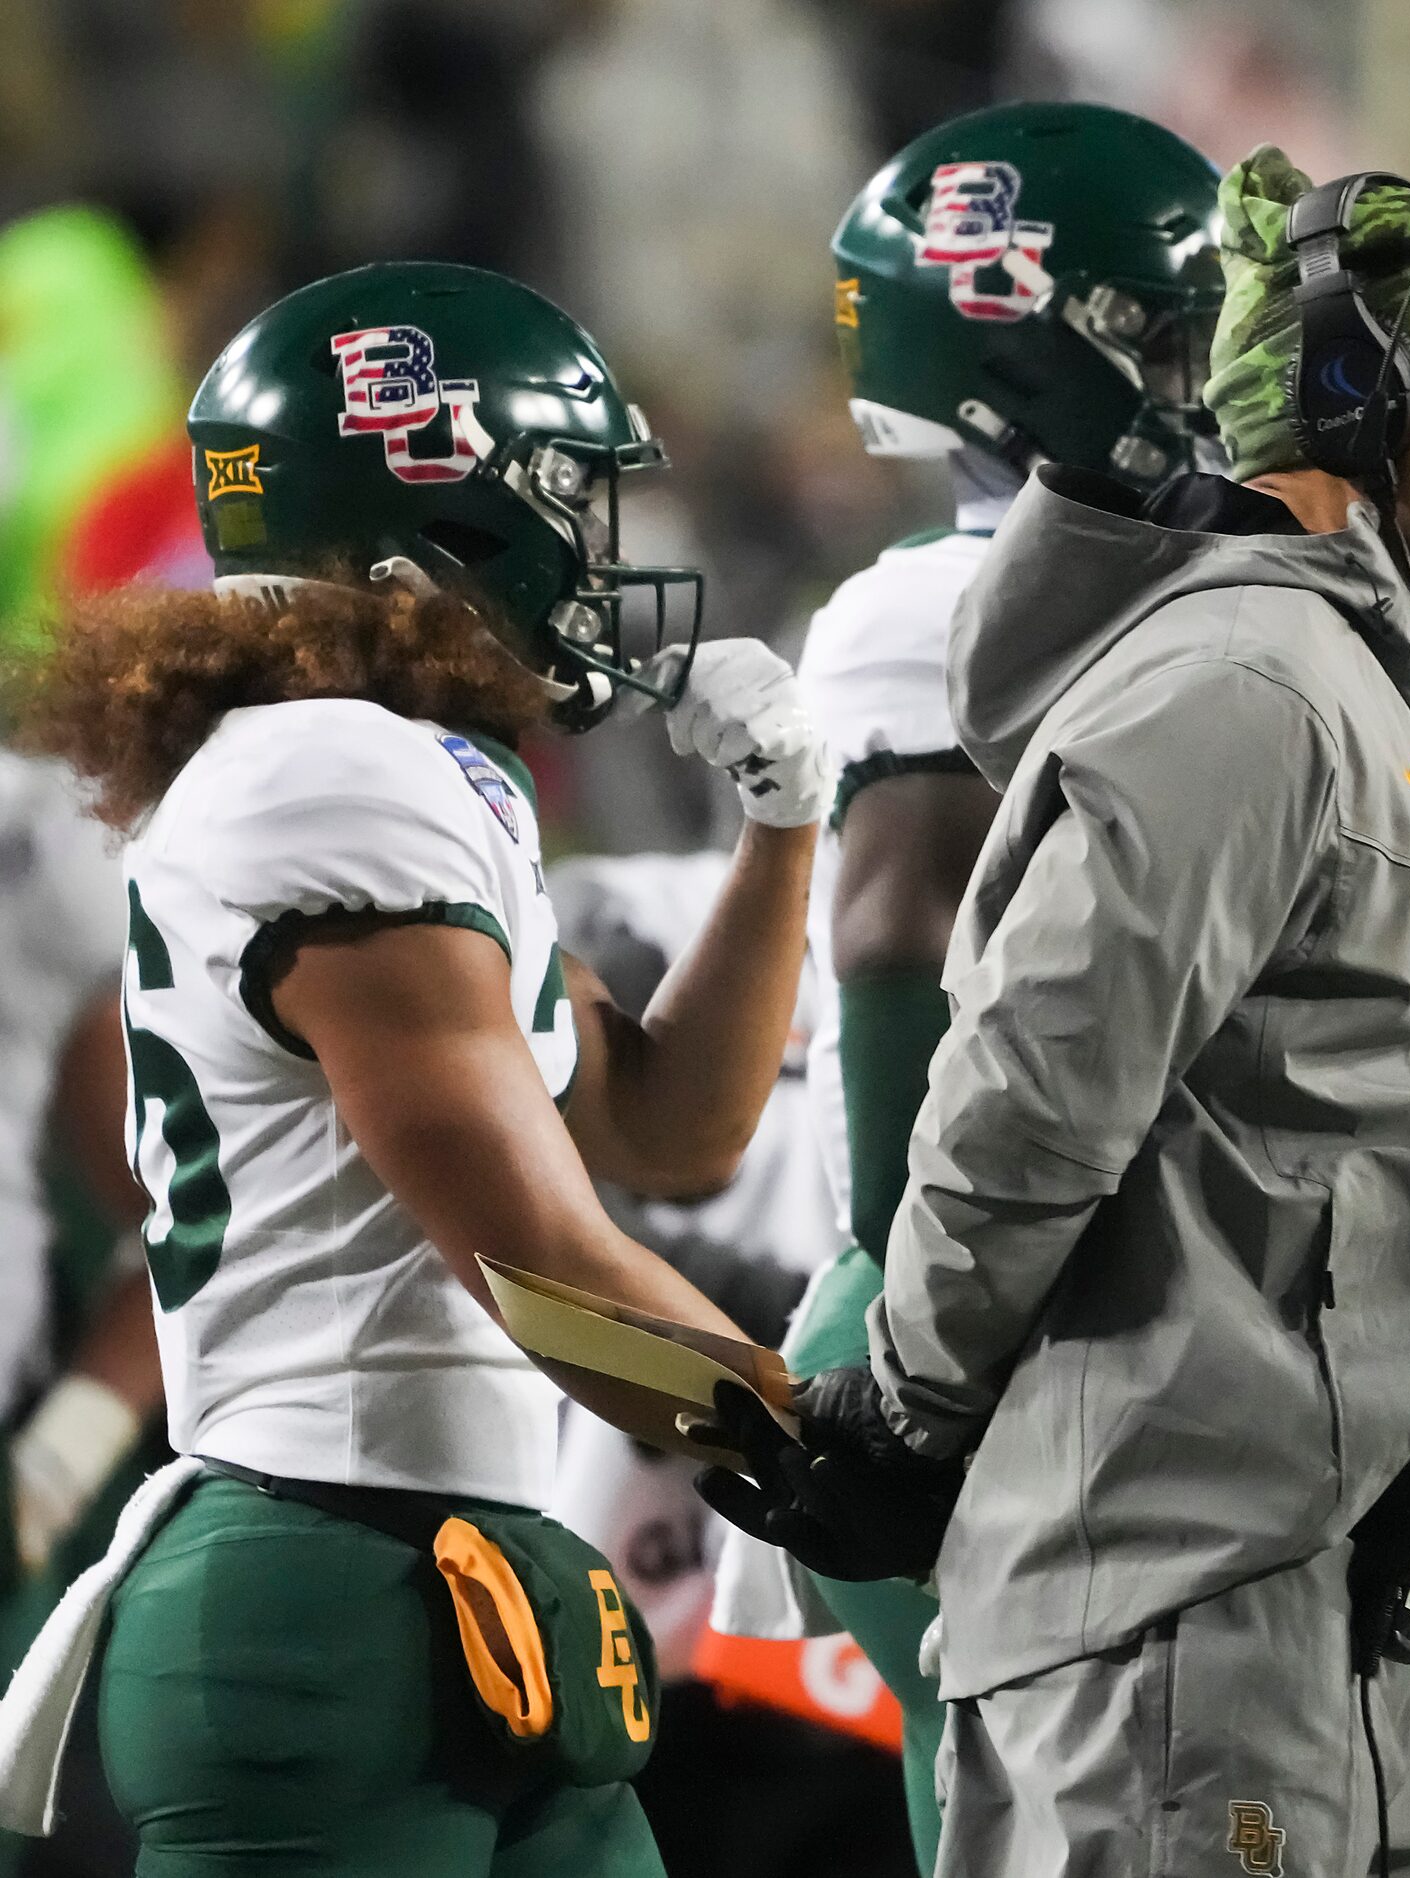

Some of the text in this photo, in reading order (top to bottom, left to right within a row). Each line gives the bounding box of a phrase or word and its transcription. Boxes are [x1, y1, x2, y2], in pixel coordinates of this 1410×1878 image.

[914, 161, 1054, 322] BU
[331, 325, 480, 483] BU
[588, 1569, 650, 1742] BU
[1227, 1800, 1286, 1878] BU
